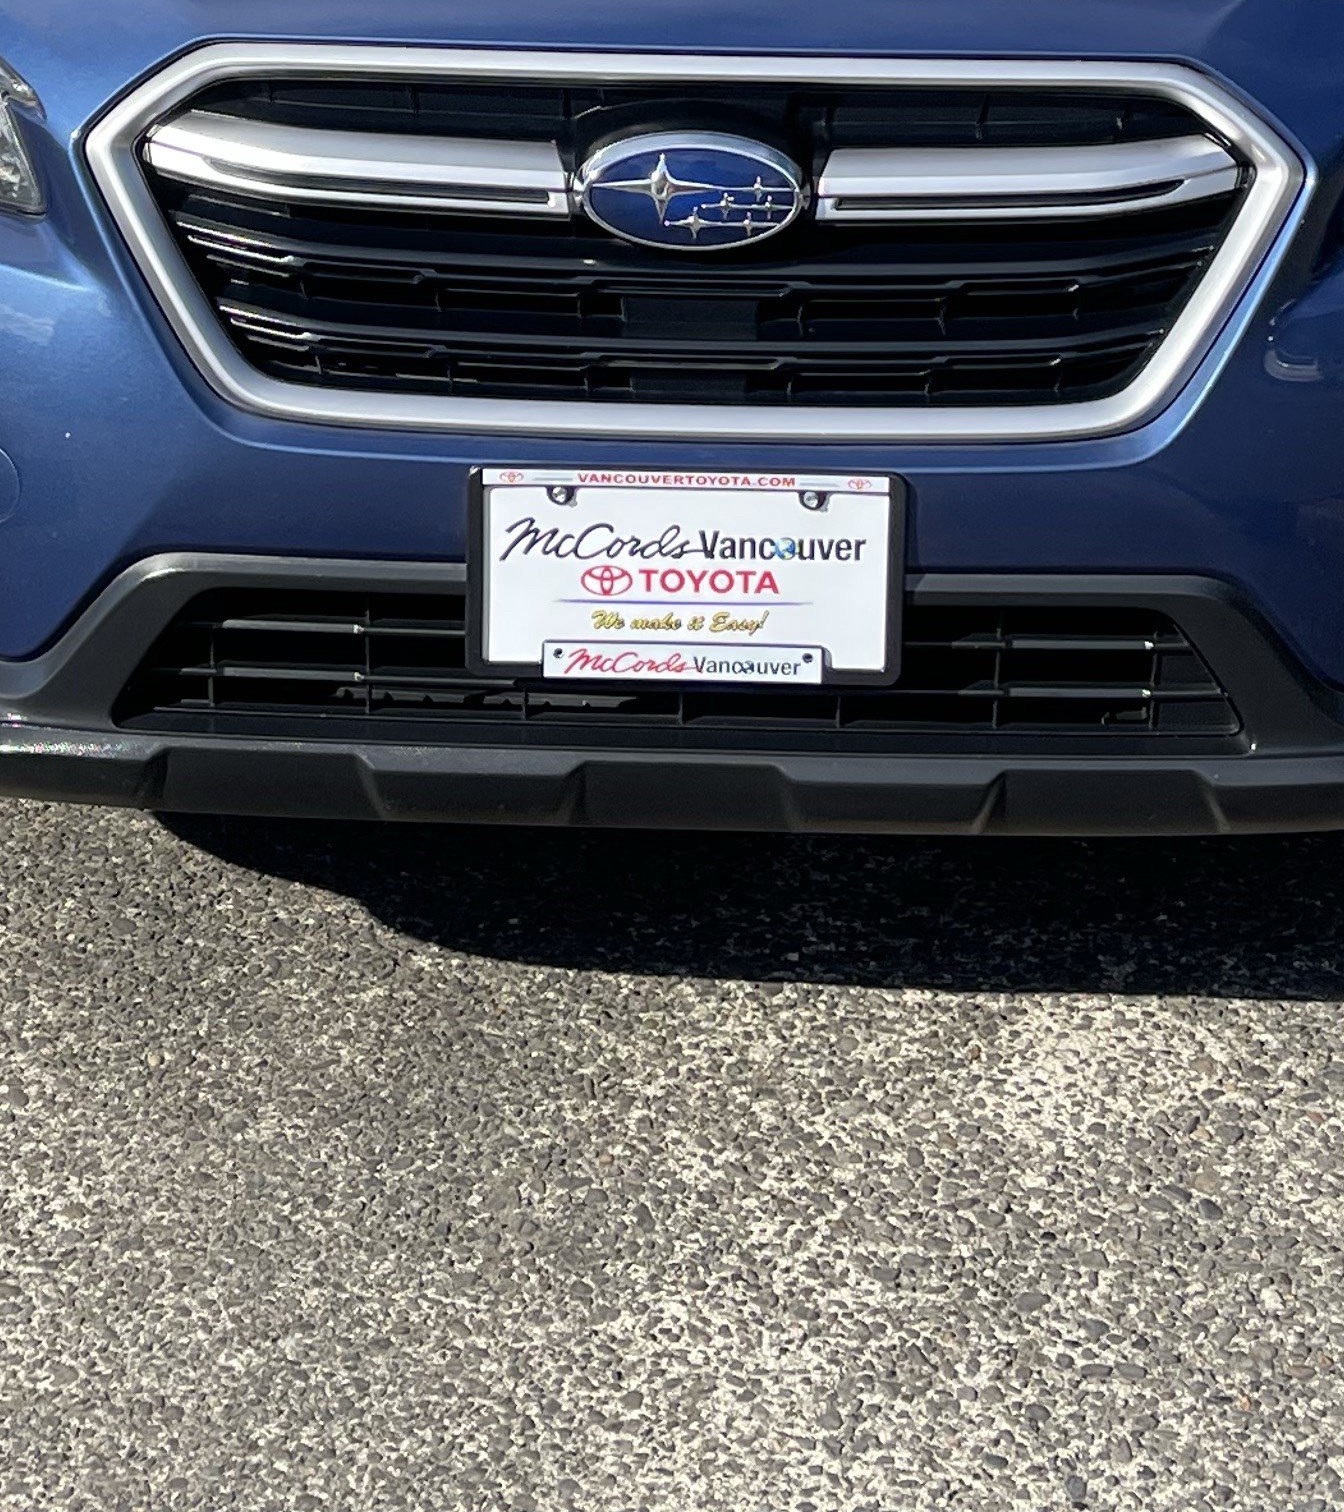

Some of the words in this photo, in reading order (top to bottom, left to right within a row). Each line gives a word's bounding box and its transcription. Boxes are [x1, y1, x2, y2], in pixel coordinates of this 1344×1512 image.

[577, 472, 796, 488] VANCOUVERTOYOTA.COM
[499, 516, 704, 562] McCords
[698, 529, 867, 562] Vancouver
[639, 569, 779, 594] TOYOTA
[591, 610, 626, 631] We
[630, 612, 682, 631] make
[687, 613, 705, 631] it
[708, 610, 770, 636] Easy!
[564, 648, 696, 675] McCords
[692, 656, 803, 677] Vancouver
